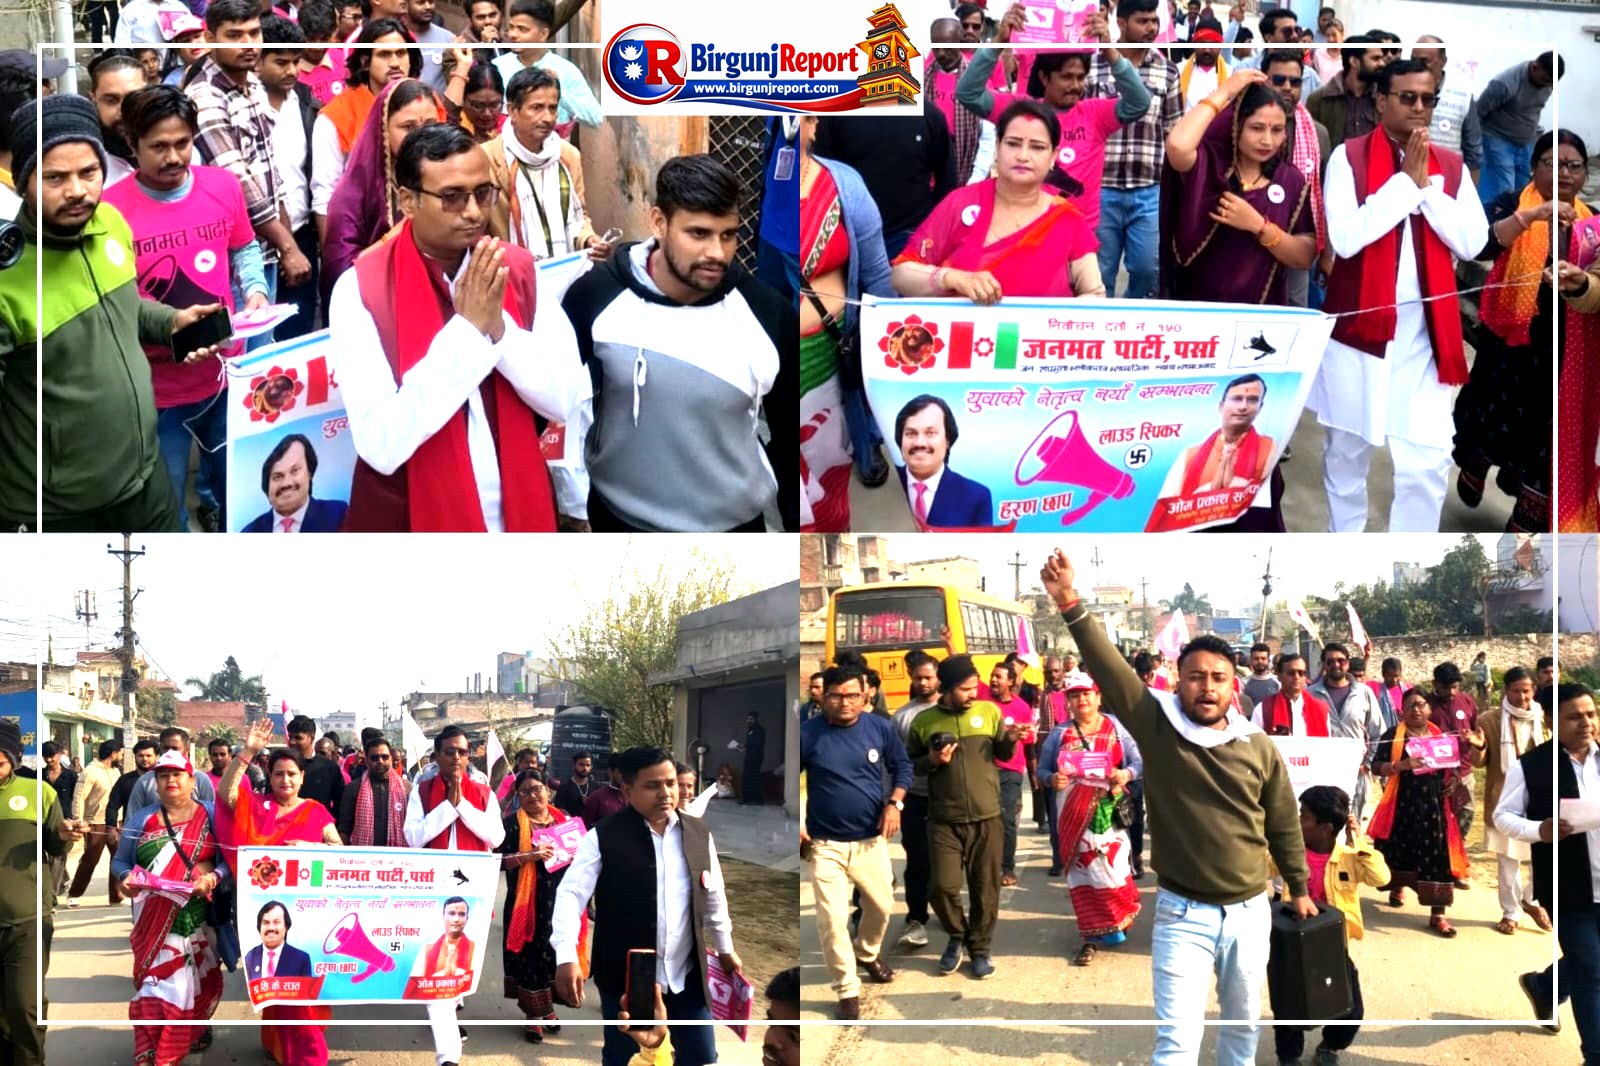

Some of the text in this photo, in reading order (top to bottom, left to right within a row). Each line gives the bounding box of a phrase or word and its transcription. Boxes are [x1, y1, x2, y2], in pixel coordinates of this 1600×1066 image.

[1022, 338, 1105, 360] जनमत
[967, 382, 1216, 413] युवाको नेतृत्व नयाँ सम्भावना
[1099, 427, 1136, 445] लाउड
[1000, 492, 1073, 519] हरण छाप
[1168, 498, 1194, 514] ओम
[1197, 493, 1230, 509] प्रकाश
[325, 868, 371, 882] जनमत
[371, 927, 393, 937] लाउड
[315, 963, 337, 974] हरण
